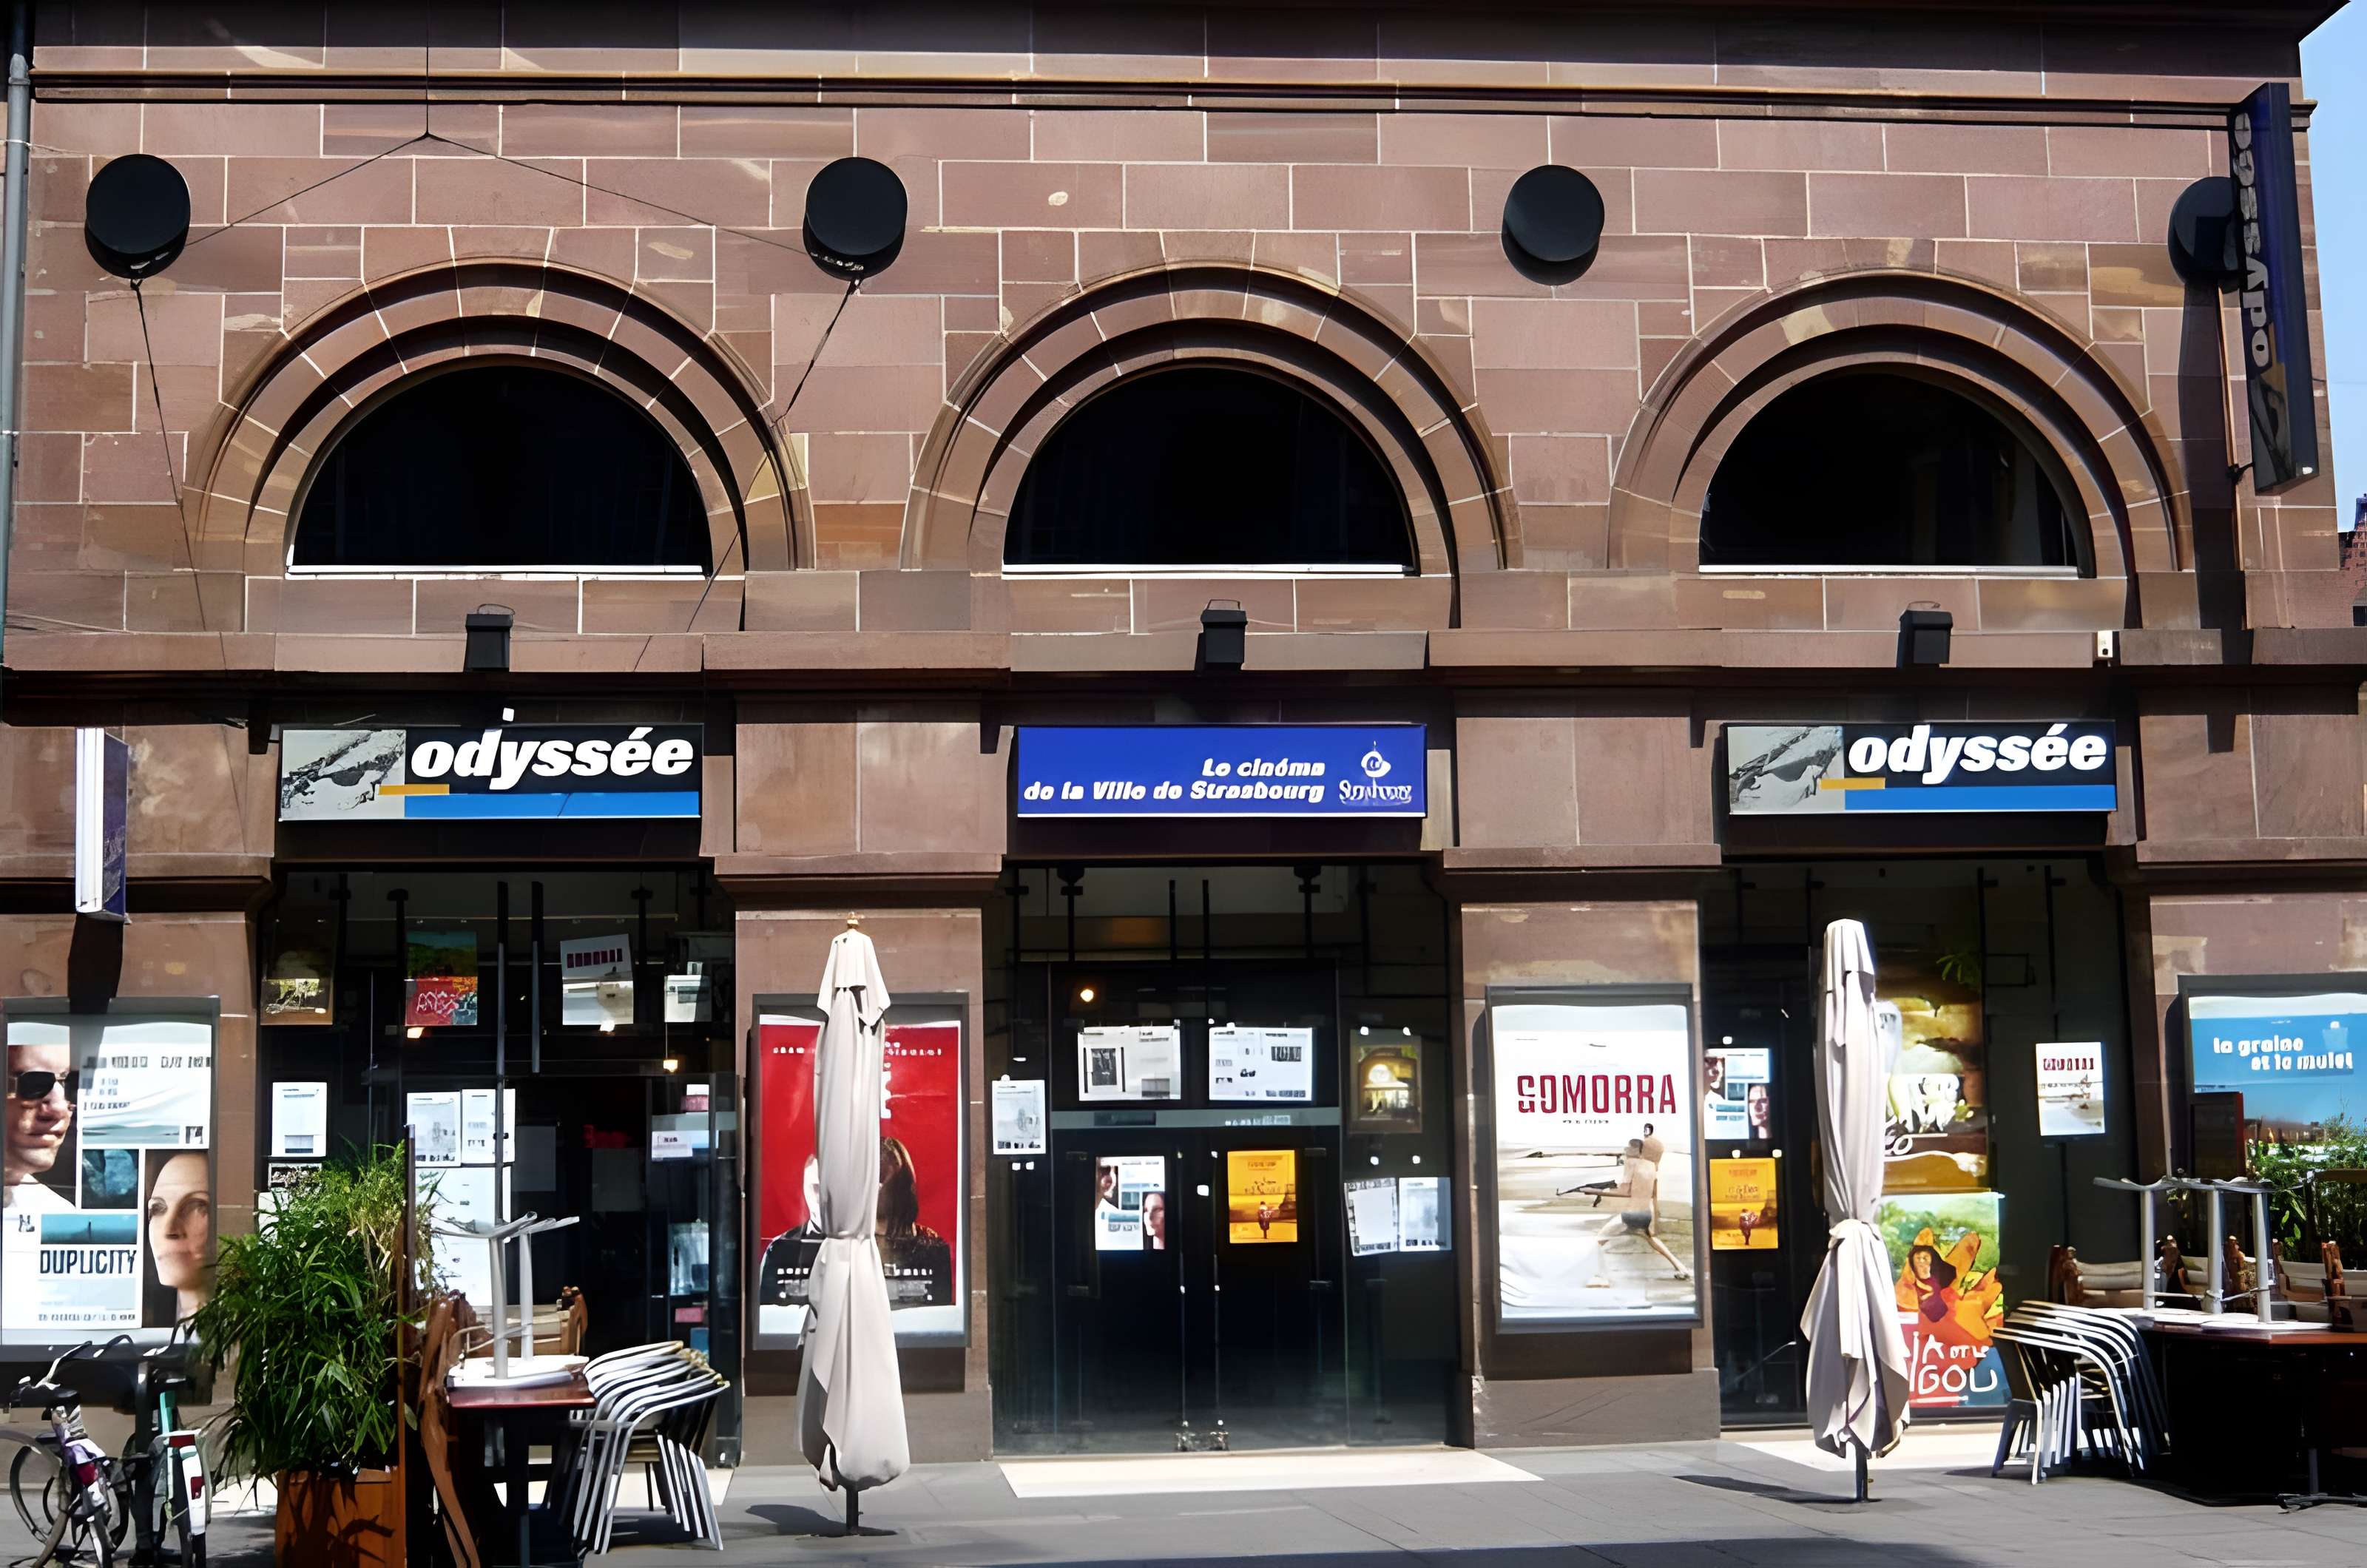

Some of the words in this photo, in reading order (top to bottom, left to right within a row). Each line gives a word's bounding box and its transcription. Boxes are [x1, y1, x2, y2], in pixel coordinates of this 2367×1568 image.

[411, 727, 694, 790] odyssée
[1848, 723, 2107, 784] odyssée
[1061, 781, 1084, 800] la
[1190, 780, 1325, 803] Strasbourg
[40, 1249, 138, 1274] DUPLICITY
